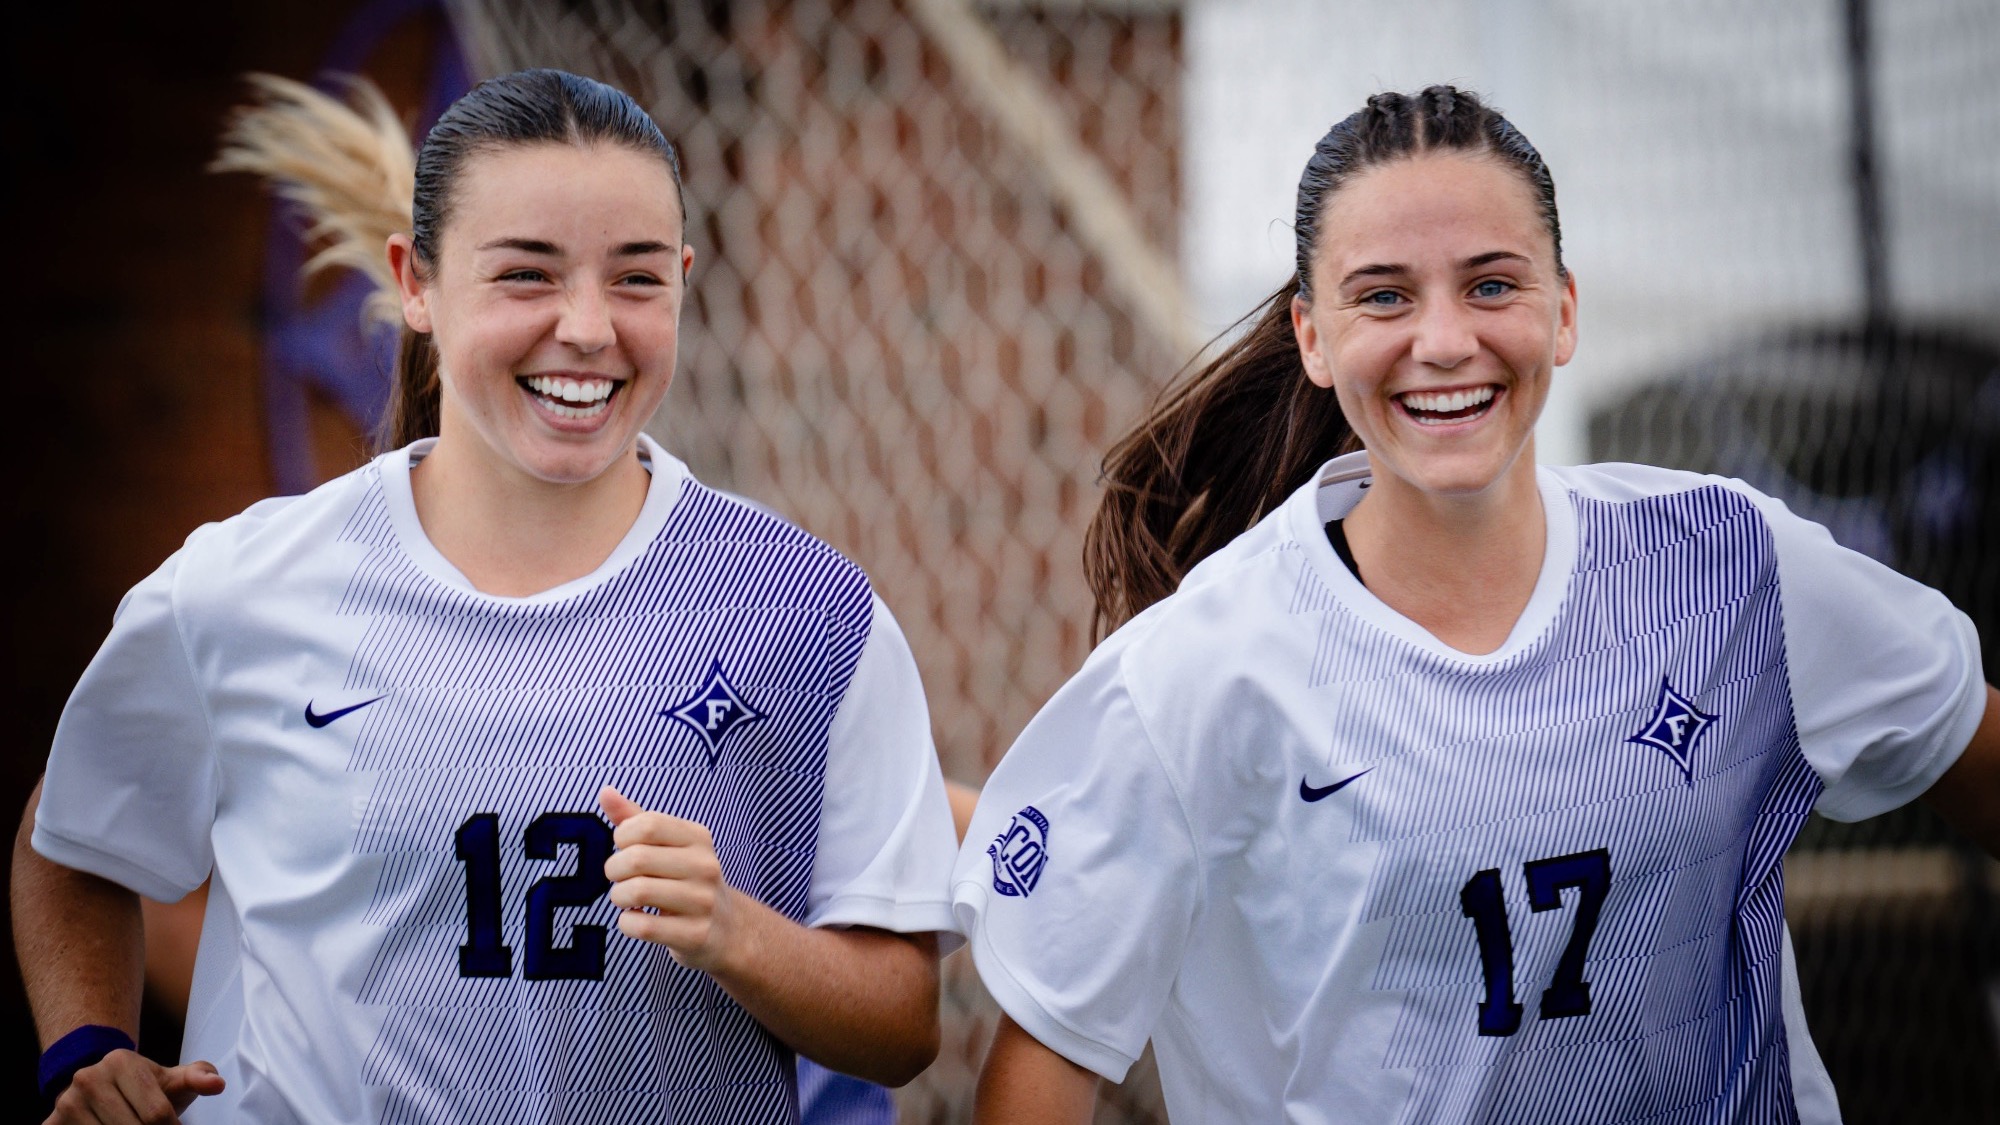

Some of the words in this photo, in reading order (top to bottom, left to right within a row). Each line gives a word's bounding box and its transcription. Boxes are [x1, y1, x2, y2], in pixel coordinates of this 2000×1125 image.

[706, 700, 732, 730] F
[1665, 714, 1689, 746] F
[455, 812, 615, 981] 12
[1460, 847, 1612, 1037] 17
